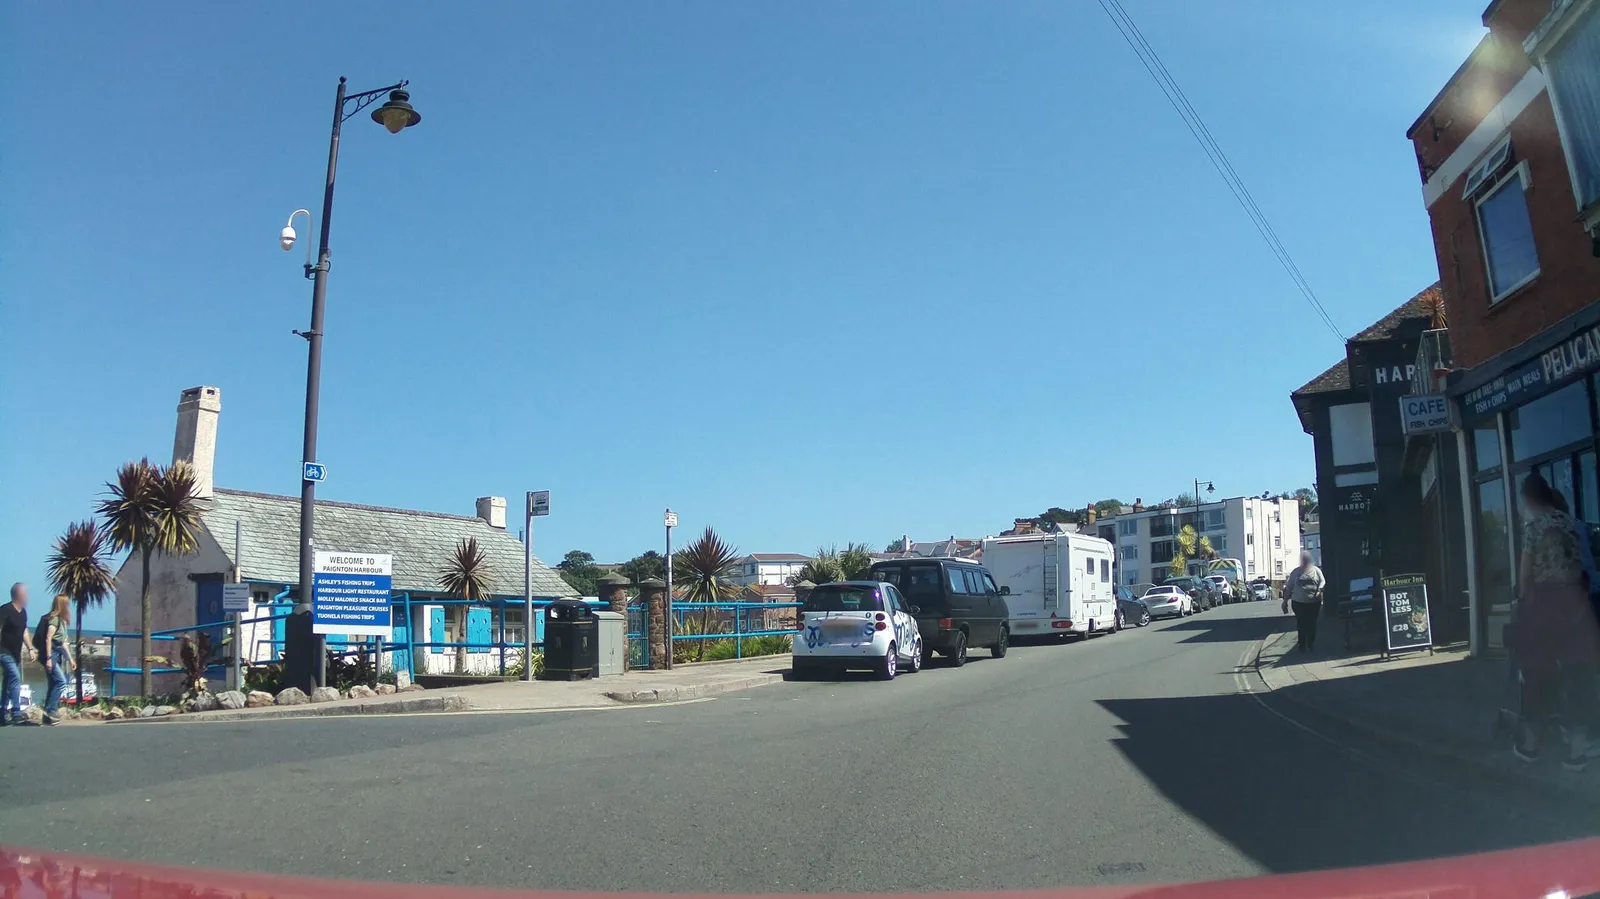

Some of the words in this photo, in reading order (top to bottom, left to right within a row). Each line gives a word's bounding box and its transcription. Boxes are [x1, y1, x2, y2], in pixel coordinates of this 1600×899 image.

[1408, 399, 1446, 416] CAFE
[1410, 421, 1426, 429] FISH
[1428, 417, 1448, 427] CHIPS
[329, 556, 364, 565] WELCOME
[323, 565, 353, 573] PAIGNTON
[354, 566, 383, 574] HARBOUR
[1384, 578, 1411, 586] Harbour
[1390, 592, 1408, 600] BOT
[1390, 599, 1410, 607] TOM
[1391, 605, 1412, 614] LESS
[1392, 623, 1409, 632] £28
